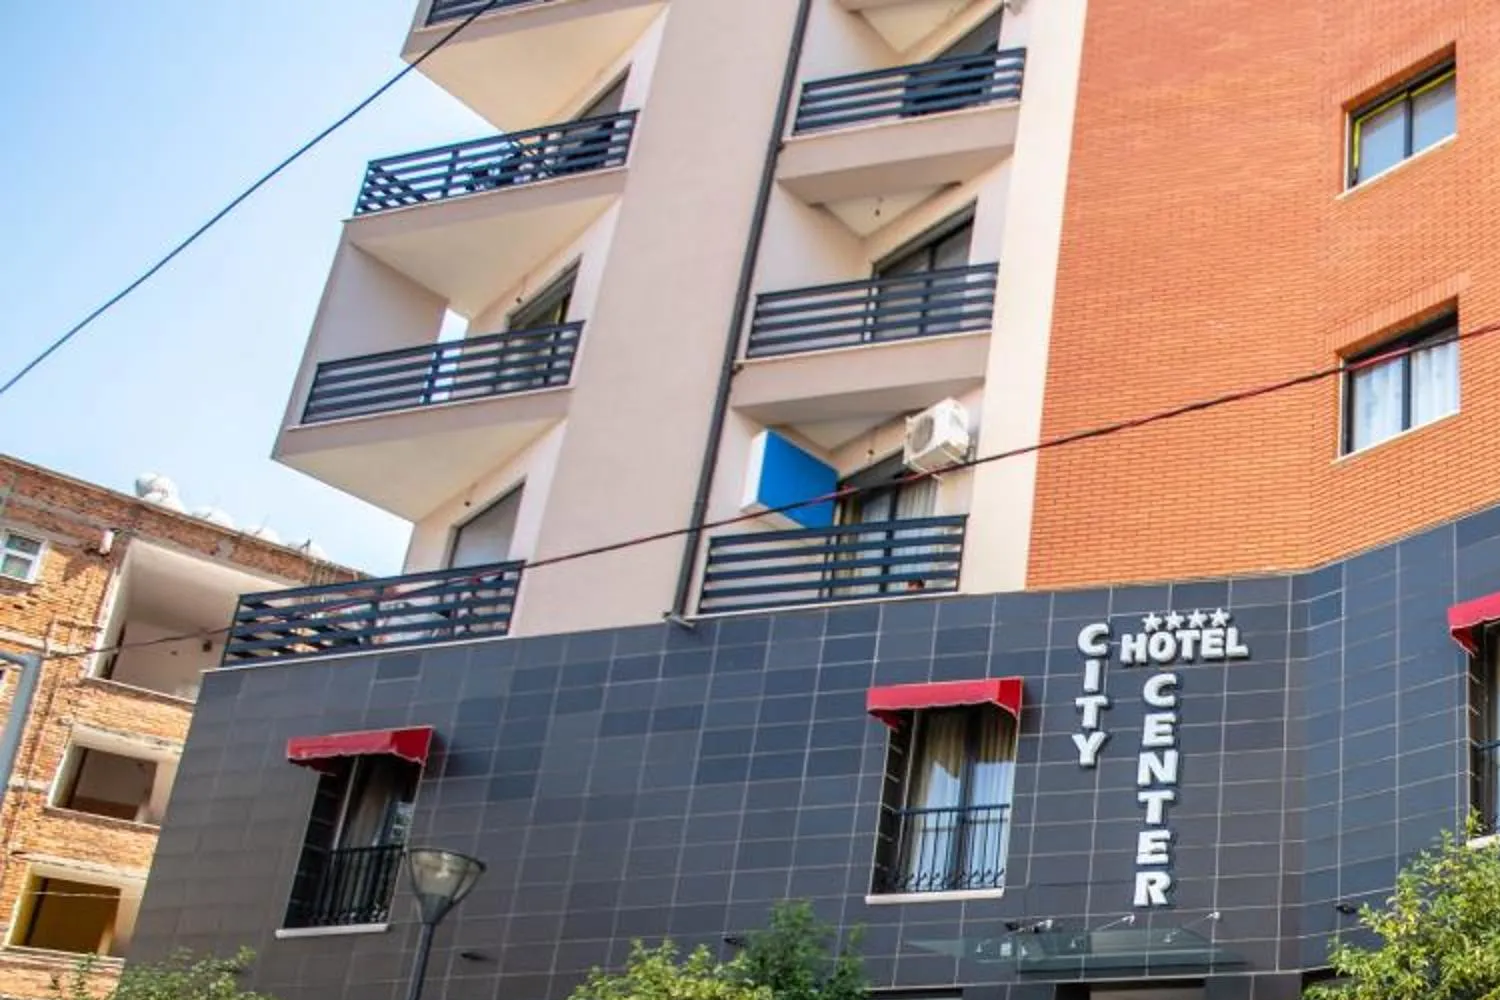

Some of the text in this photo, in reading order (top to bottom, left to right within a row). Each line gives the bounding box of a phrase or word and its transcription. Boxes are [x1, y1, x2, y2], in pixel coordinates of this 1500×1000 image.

[1072, 623, 1109, 767] CITY
[1119, 626, 1249, 664] HOTEL
[1133, 673, 1179, 907] CENTER
